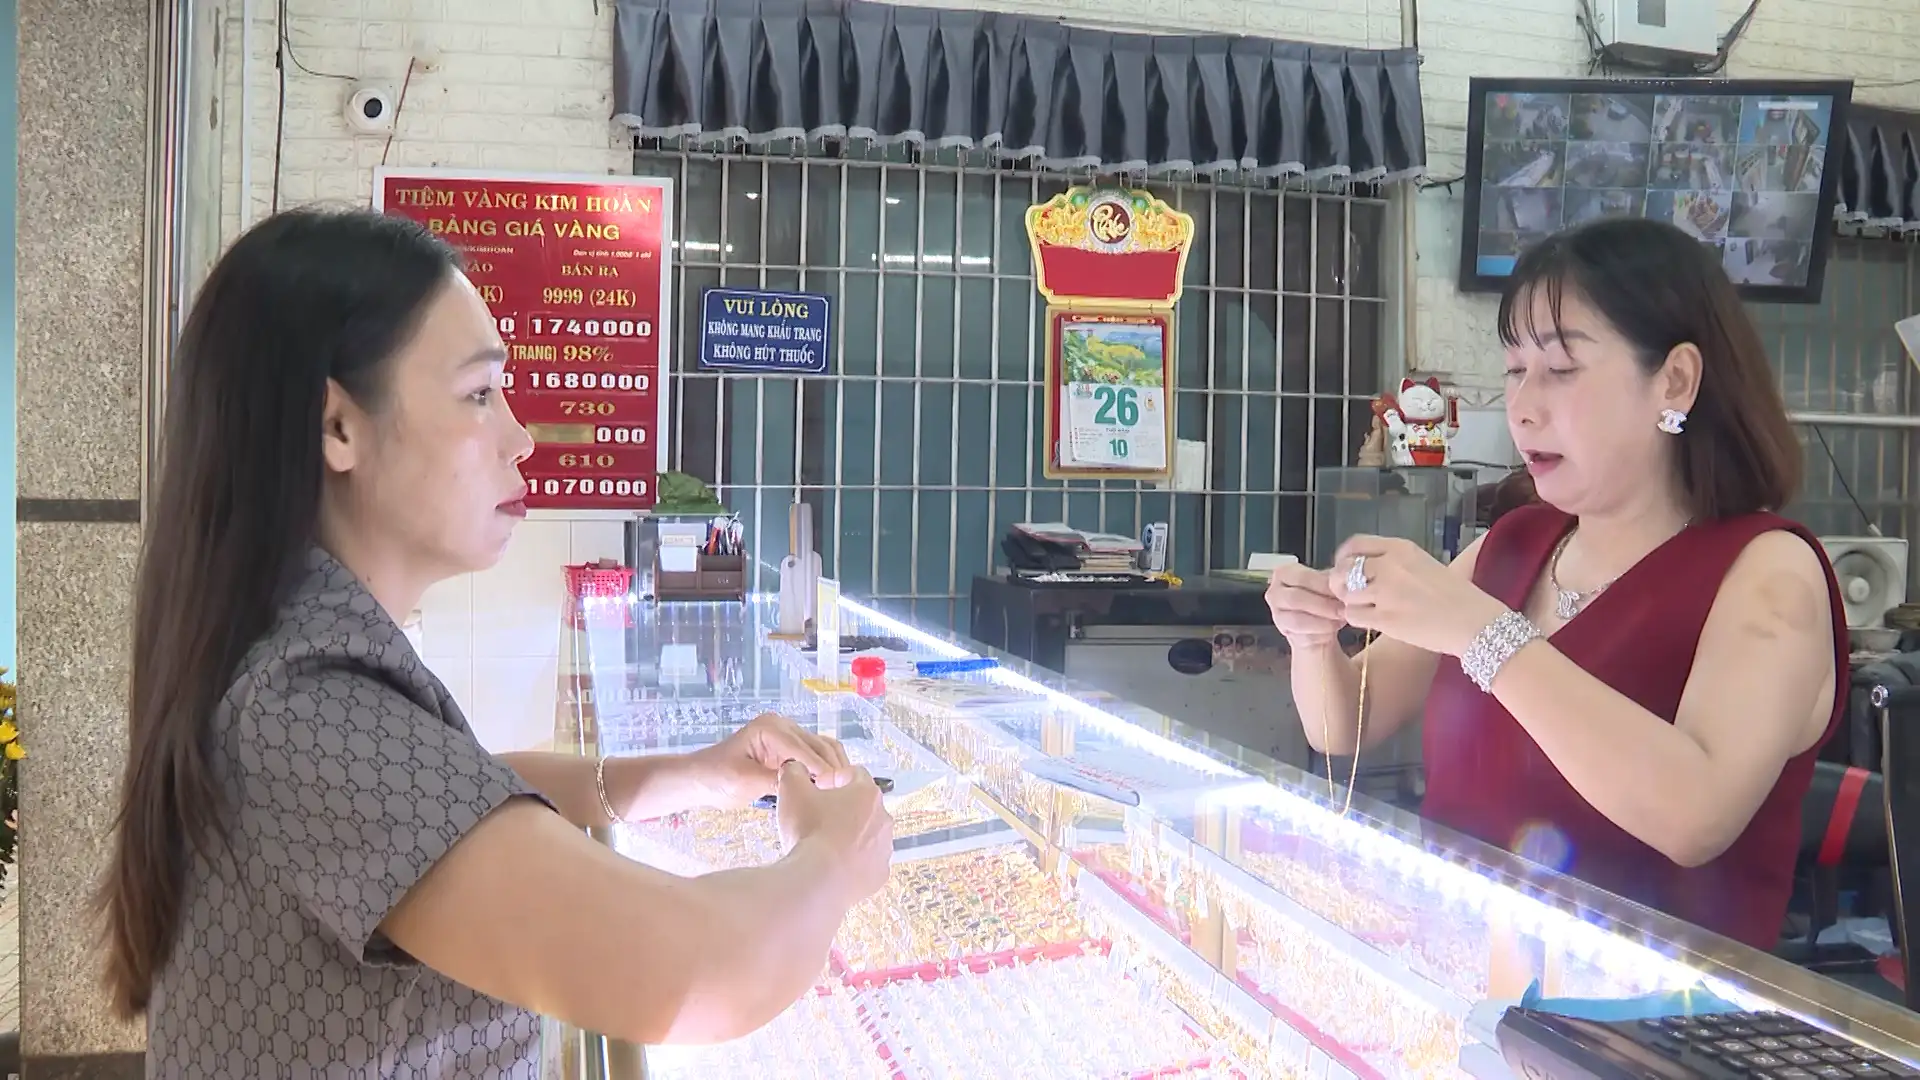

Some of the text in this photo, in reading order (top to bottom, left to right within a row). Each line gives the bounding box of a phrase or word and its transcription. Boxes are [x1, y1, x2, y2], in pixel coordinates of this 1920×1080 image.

[396, 185, 454, 210] TIỆM
[462, 188, 527, 209] VÀNG
[534, 194, 578, 212] KIM
[429, 213, 620, 240] BẢNG GIÁ VÀNG
[562, 262, 593, 276] BÁN
[543, 286, 637, 308] 9999 (24K)
[723, 297, 809, 318] VUI LÒNG
[531, 318, 651, 337] 1740000
[708, 318, 739, 336] KHÔNG
[740, 323, 765, 338] MANG
[794, 326, 821, 342] TRANG
[512, 344, 557, 362] TRANG)
[563, 345, 614, 362] 98%
[713, 341, 815, 364] KHÔNG HÚT THUỐC
[529, 372, 649, 390] 1680000
[559, 401, 615, 415] 730
[1094, 386, 1139, 426] 26
[1109, 438, 1129, 458] 10
[559, 454, 614, 468] 610
[527, 479, 647, 495] 1070000
